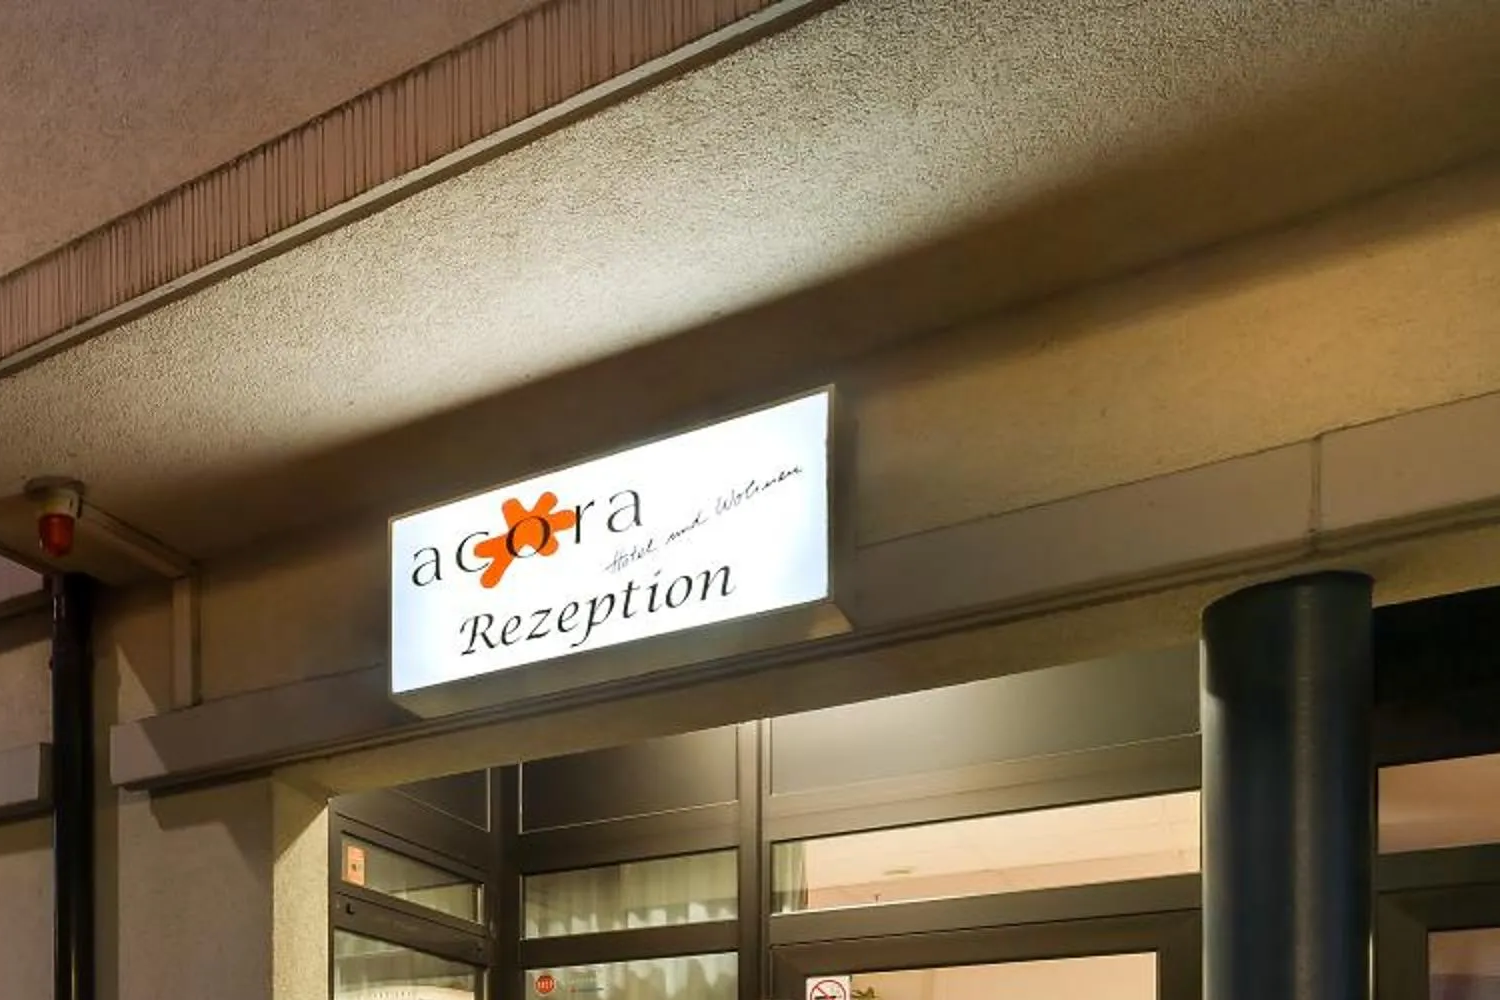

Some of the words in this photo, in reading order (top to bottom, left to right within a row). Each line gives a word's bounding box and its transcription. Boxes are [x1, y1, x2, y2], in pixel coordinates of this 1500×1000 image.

[410, 487, 643, 588] acora
[604, 538, 657, 573] Hotel
[459, 561, 738, 657] Rezeption
